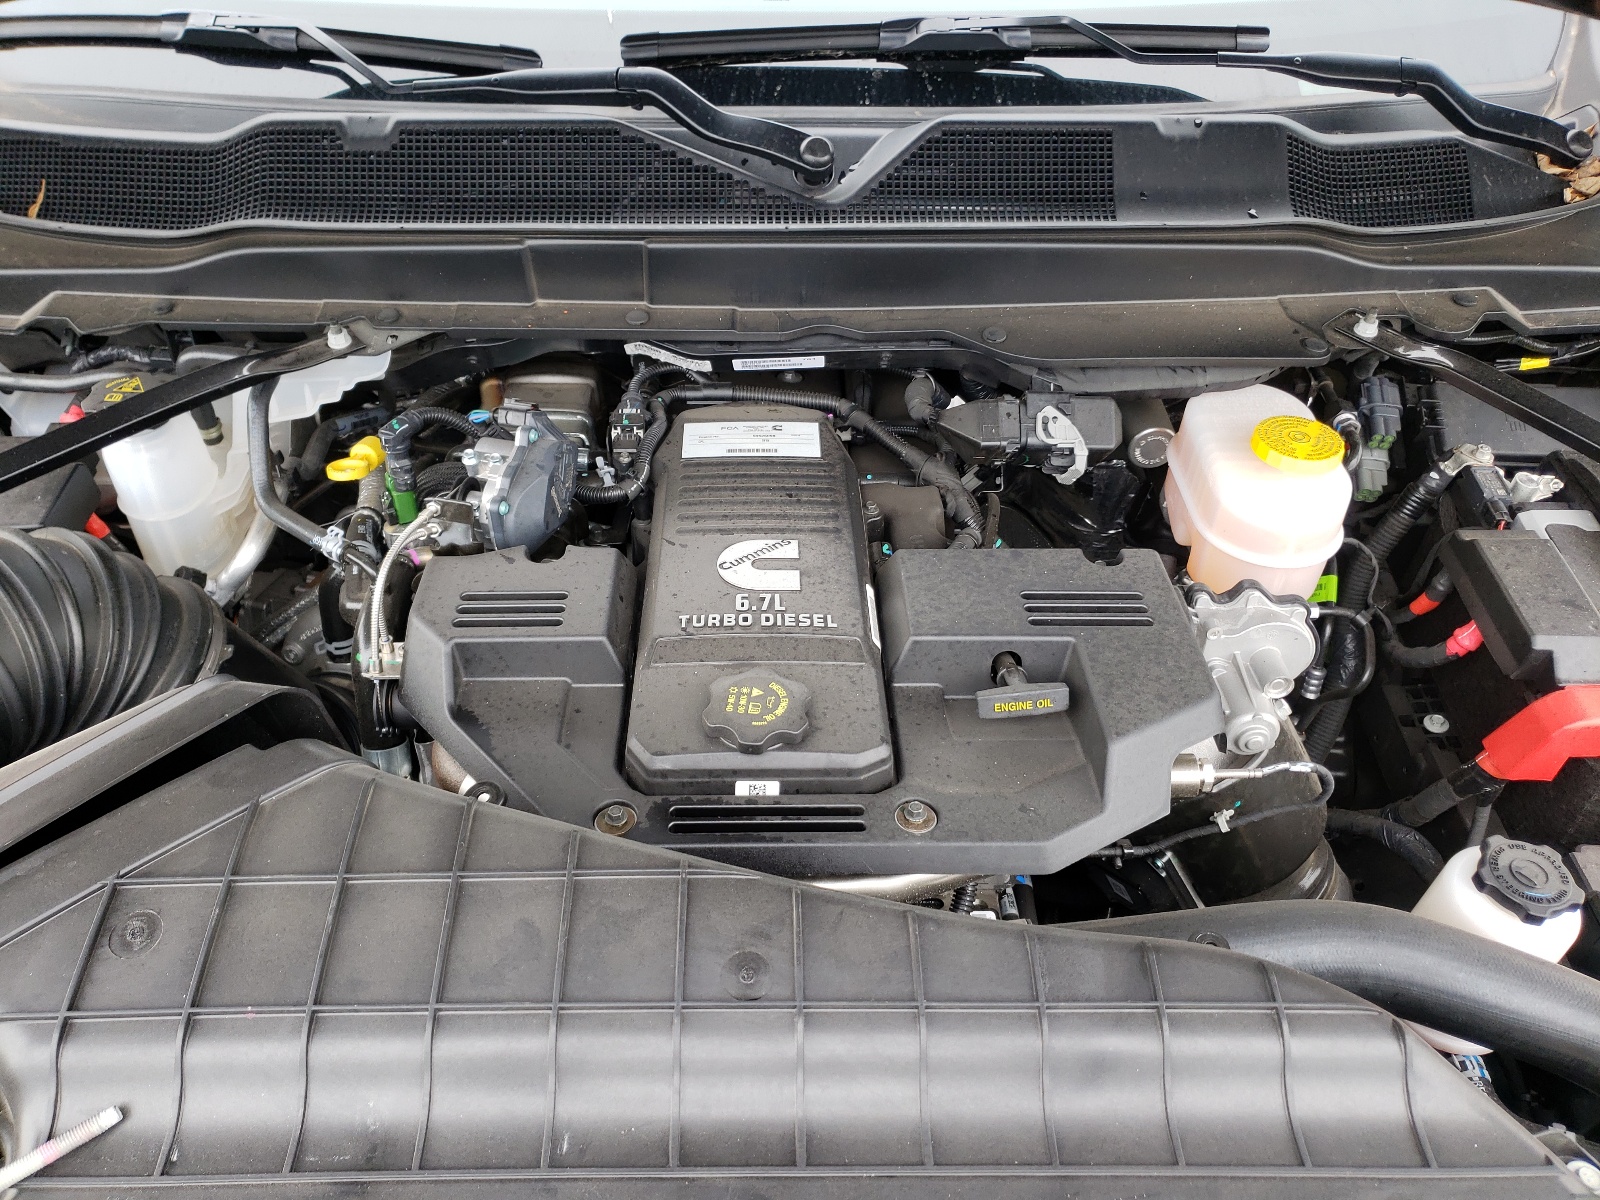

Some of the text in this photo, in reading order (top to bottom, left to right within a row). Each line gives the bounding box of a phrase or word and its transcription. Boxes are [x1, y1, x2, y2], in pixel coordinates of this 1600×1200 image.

[718, 538, 792, 570] Cummins
[735, 593, 786, 611] 6.7L
[678, 613, 838, 628] TURBO DIESEL
[762, 682, 789, 722] DIESEL ENGINE OIL
[994, 699, 1054, 712] ENGINE OIL
